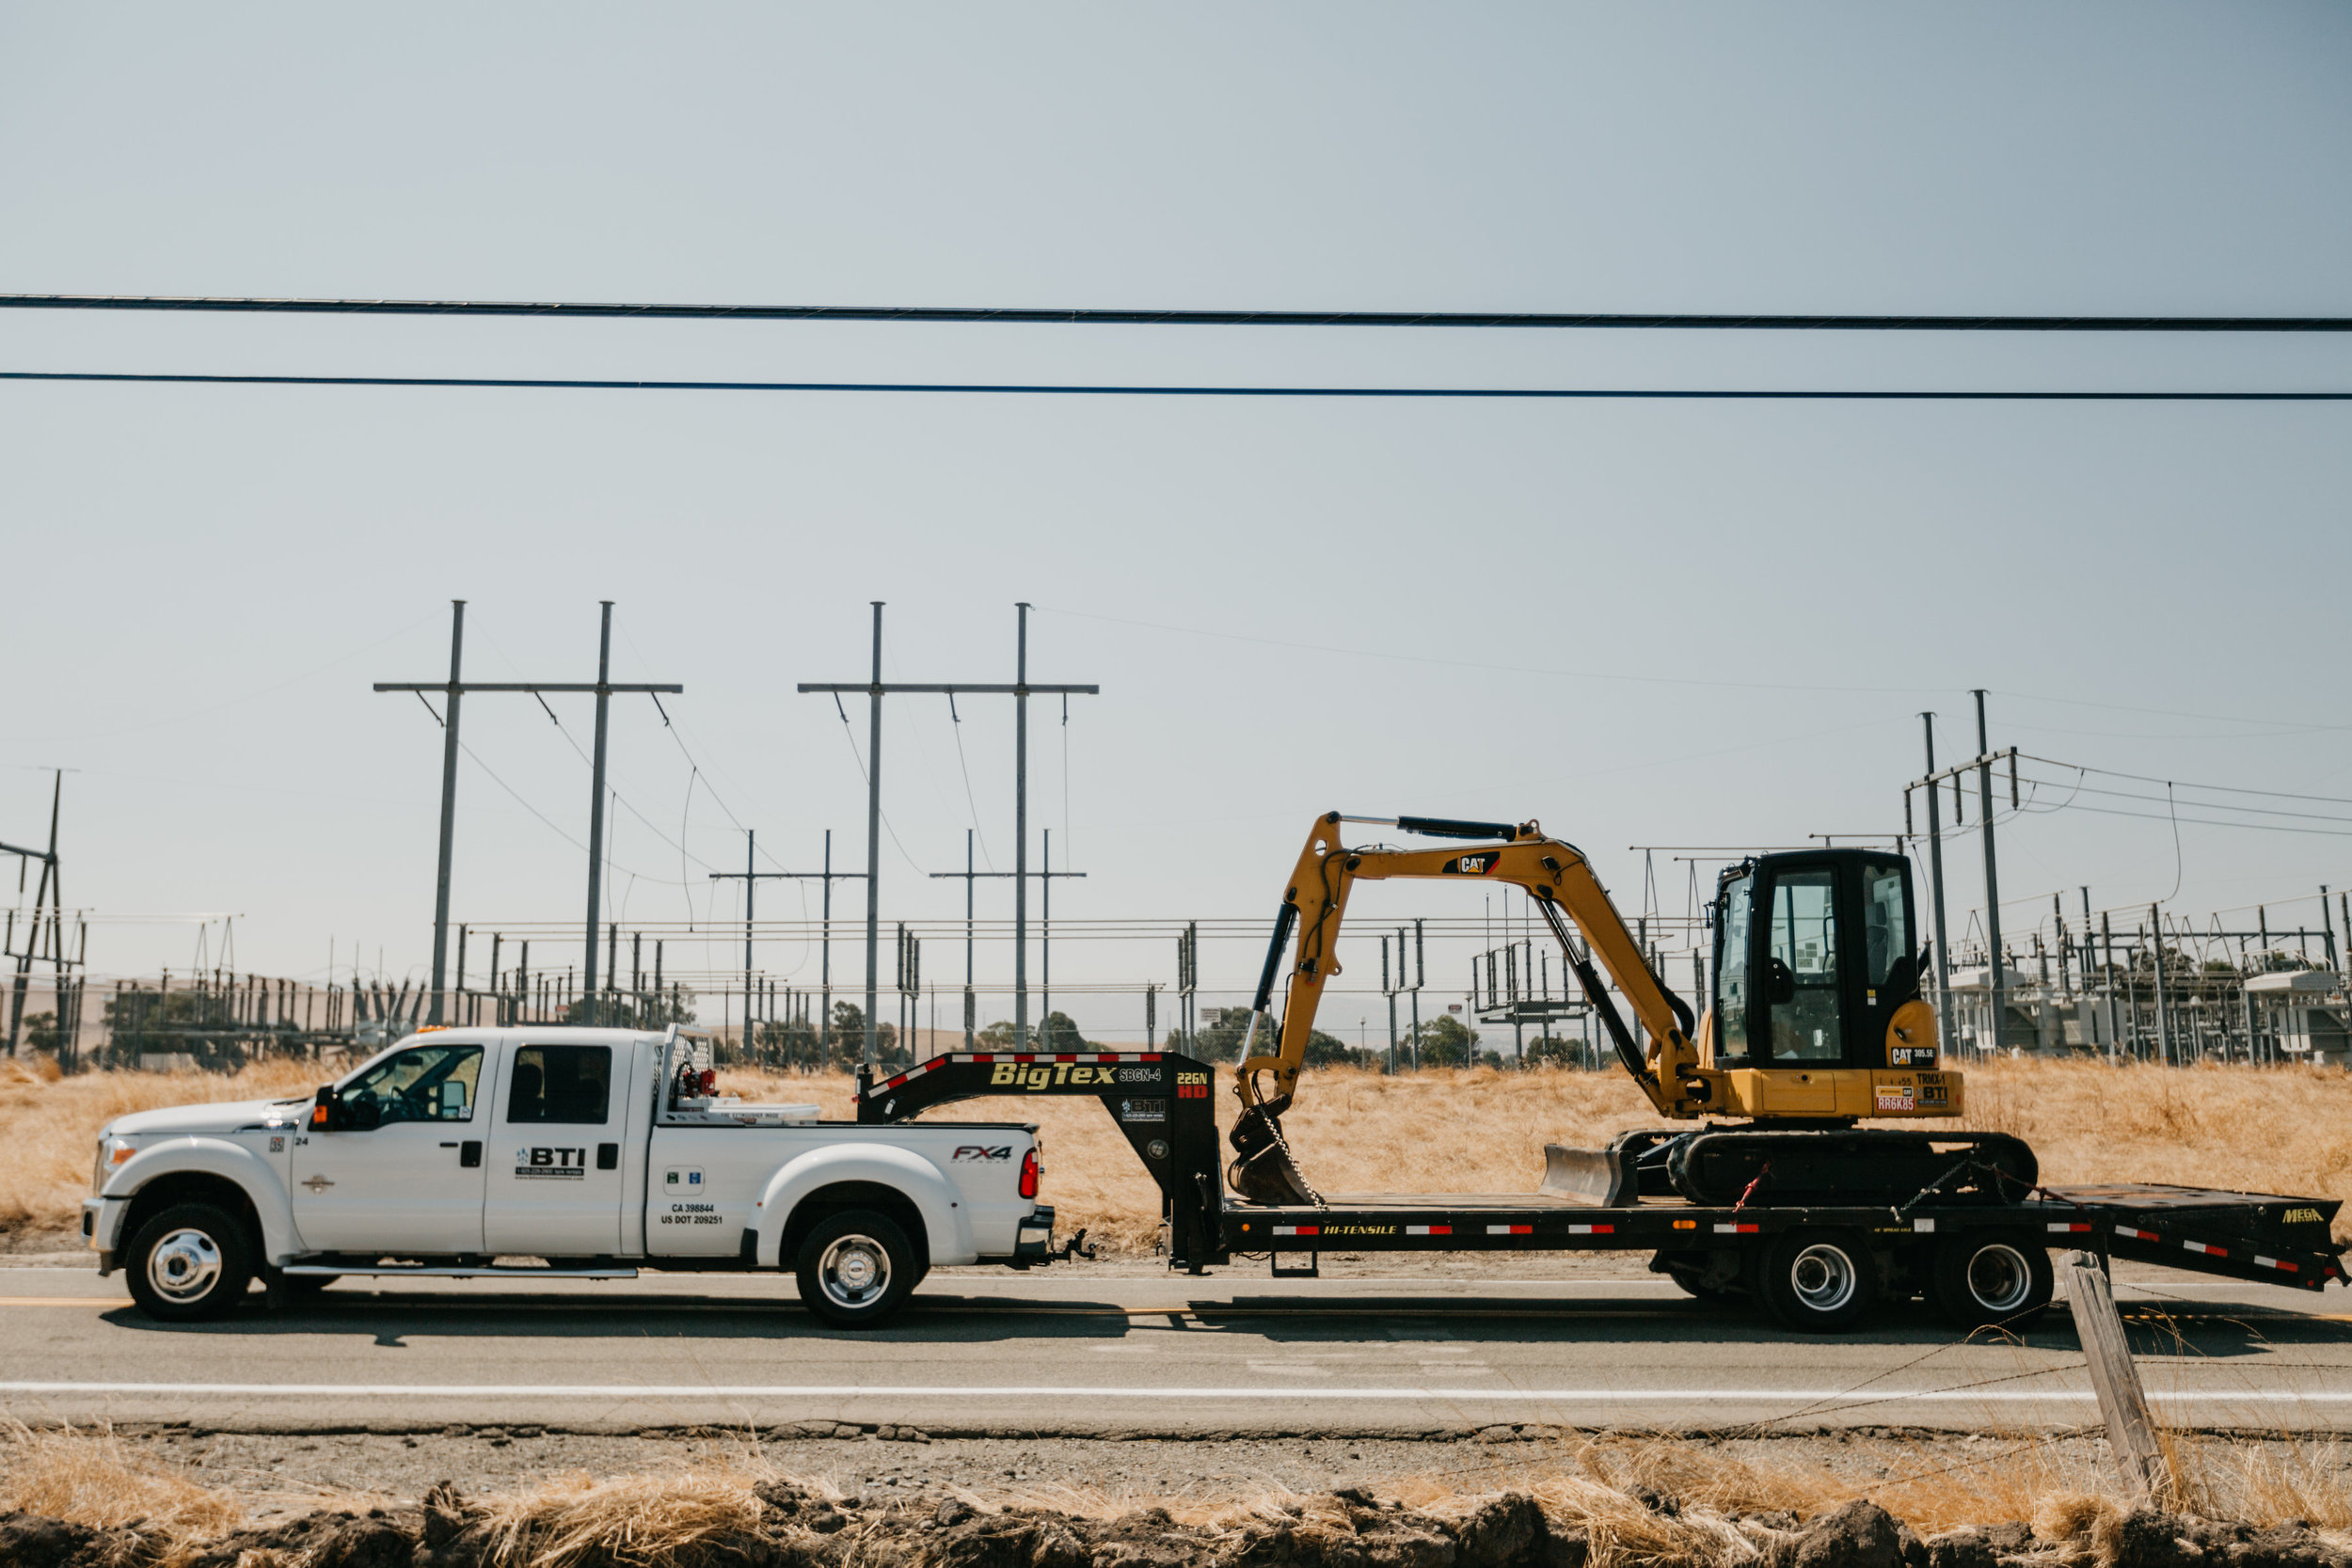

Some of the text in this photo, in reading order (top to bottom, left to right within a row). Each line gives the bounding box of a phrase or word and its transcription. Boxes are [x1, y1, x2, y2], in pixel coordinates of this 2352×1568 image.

[1461, 857, 1486, 873] CAT
[1892, 1048, 1912, 1065] CAT
[990, 1062, 1162, 1090] BigTex SBGN-4
[1177, 1072, 1208, 1085] 22GN
[1916, 1073, 1946, 1085] TRMX-1
[1178, 1085, 1208, 1099] HD
[1923, 1086, 1947, 1099] BTI
[1131, 1099, 1166, 1113] BTI
[1878, 1098, 1914, 1110] RR6K85
[295, 1137, 309, 1146] 24
[530, 1148, 585, 1166] BTI
[951, 1146, 1013, 1160] FX4
[672, 1204, 714, 1212] CA 398844
[661, 1215, 723, 1224] US DOT 209251
[2282, 1208, 2324, 1223] MEGA
[1323, 1226, 1397, 1234] HI-TENSILE
